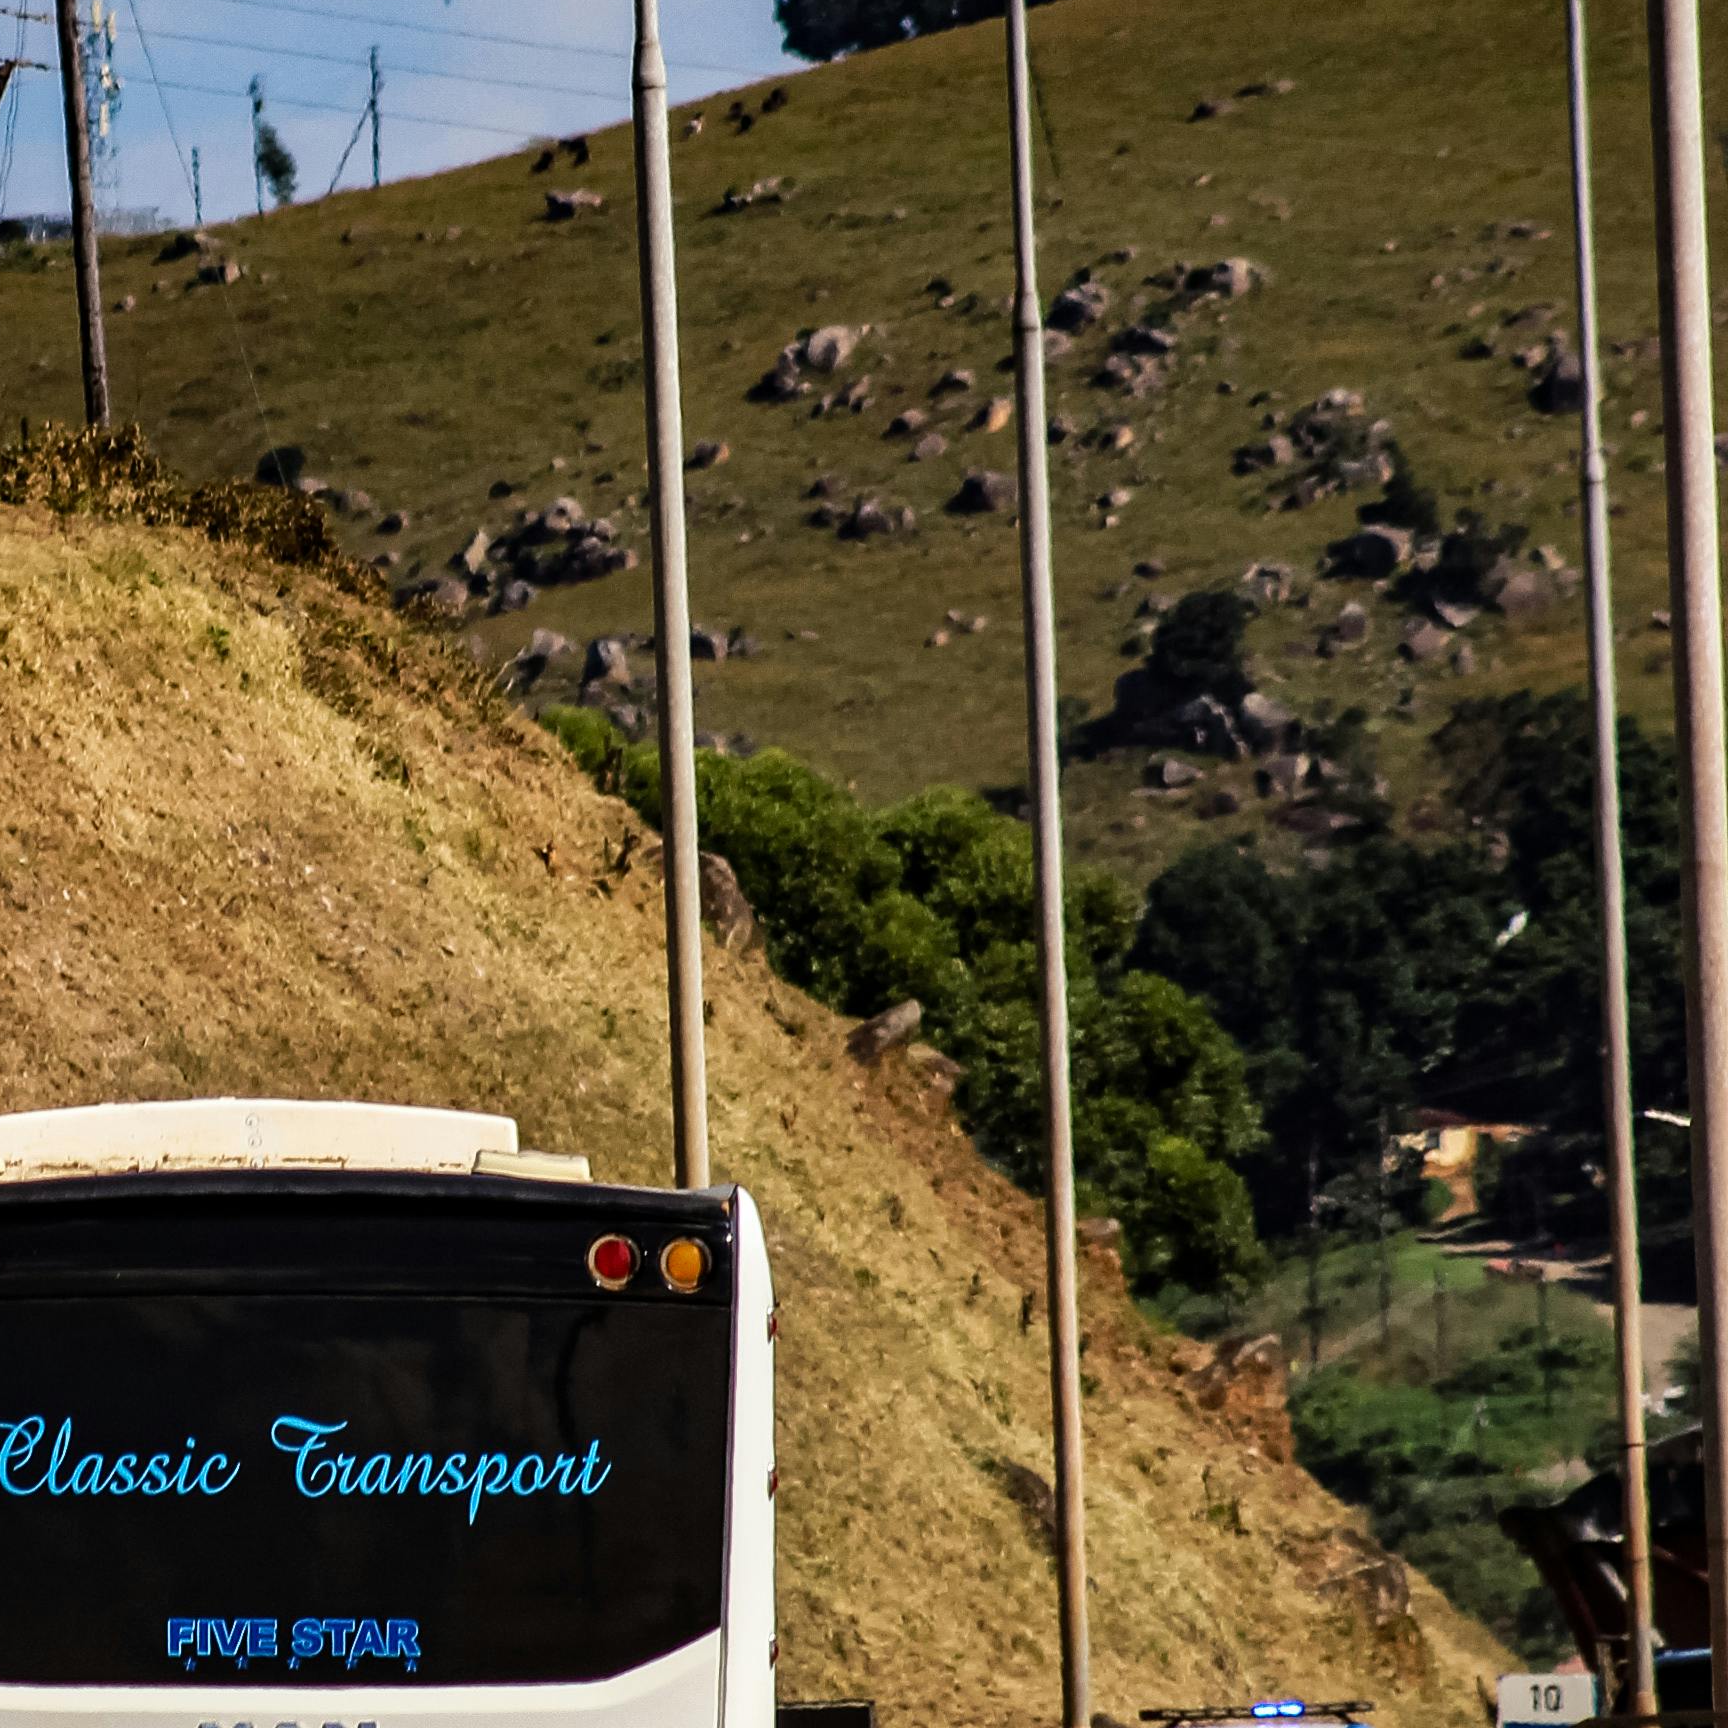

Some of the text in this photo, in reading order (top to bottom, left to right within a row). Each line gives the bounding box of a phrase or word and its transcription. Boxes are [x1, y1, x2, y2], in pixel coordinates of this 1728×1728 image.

[270, 1414, 613, 1526] Transport
[167, 1617, 421, 1658] FIVE STAR
[1529, 1683, 1562, 1712] 10
